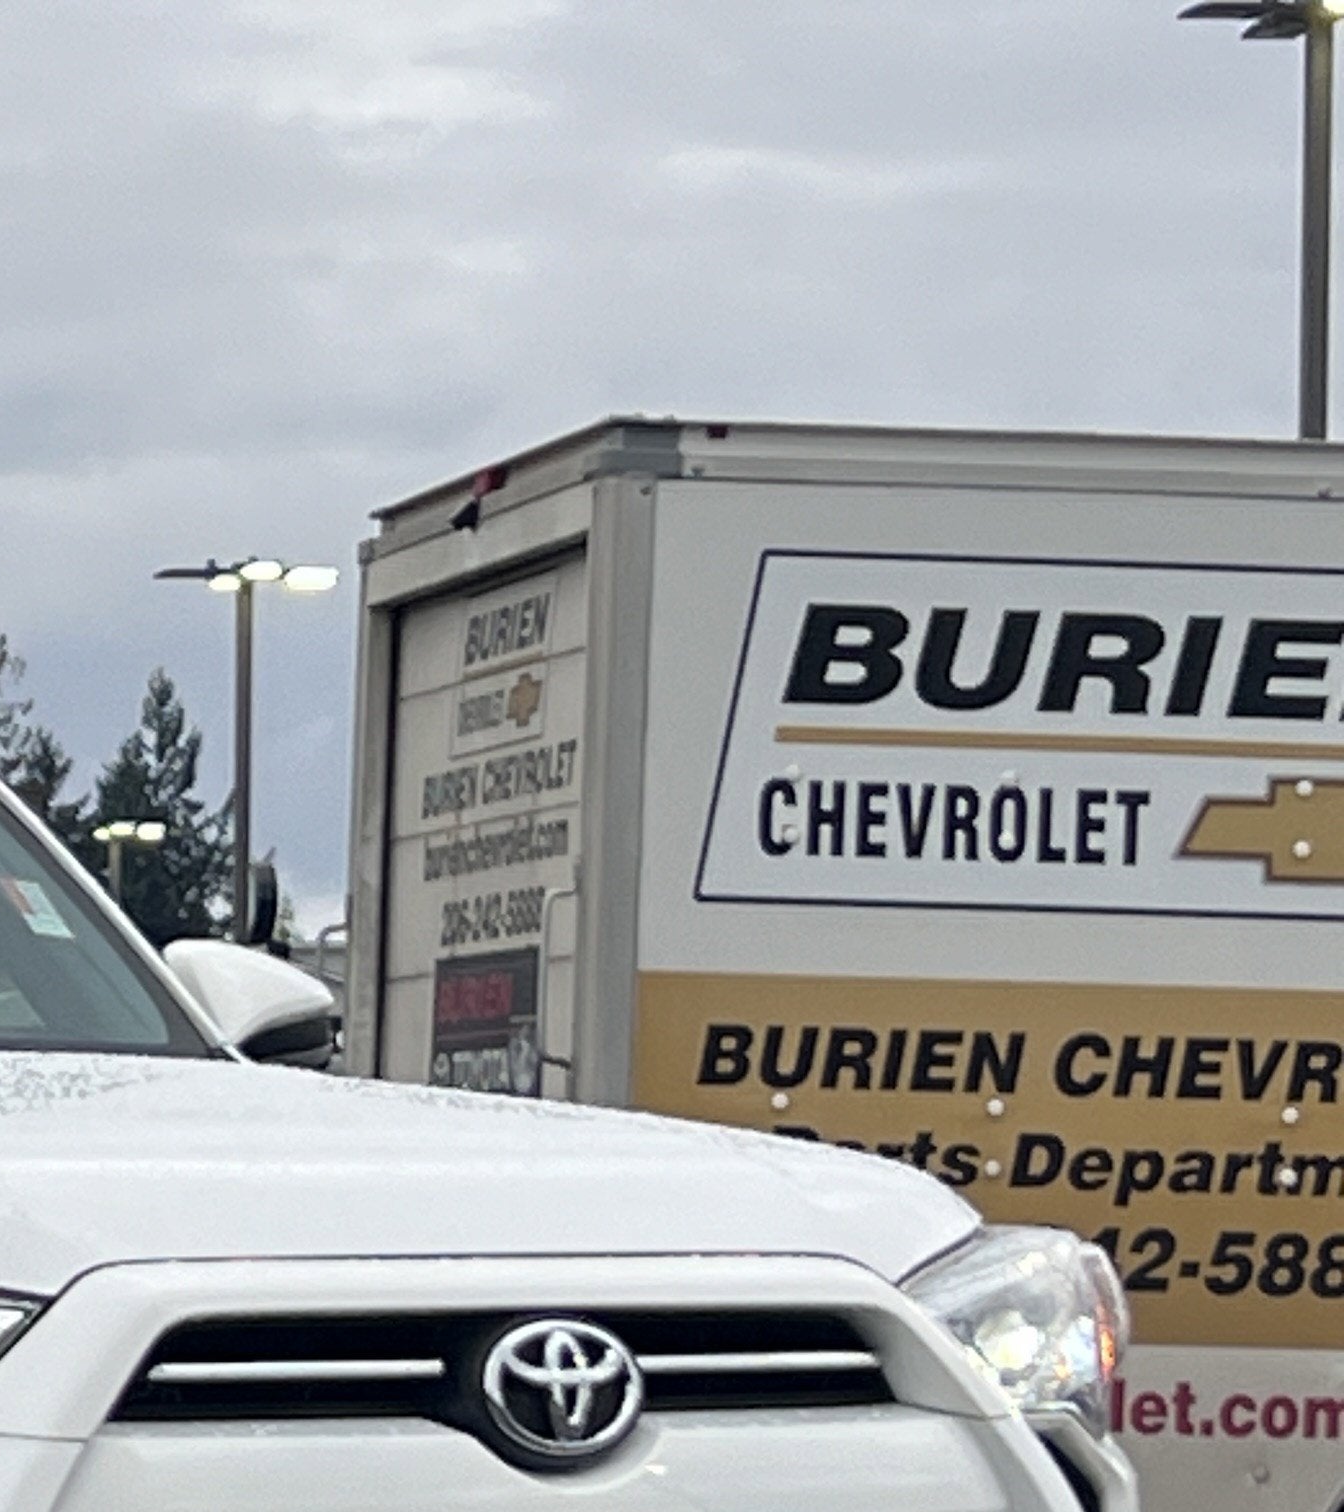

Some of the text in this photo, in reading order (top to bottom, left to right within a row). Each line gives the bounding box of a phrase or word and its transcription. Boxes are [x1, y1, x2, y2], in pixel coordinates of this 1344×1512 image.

[465, 592, 551, 666] BURIEN
[782, 602, 1344, 722] BURIE
[758, 775, 1150, 865] CHEVROLET
[698, 1024, 1343, 1102] BURIEN CHEVR
